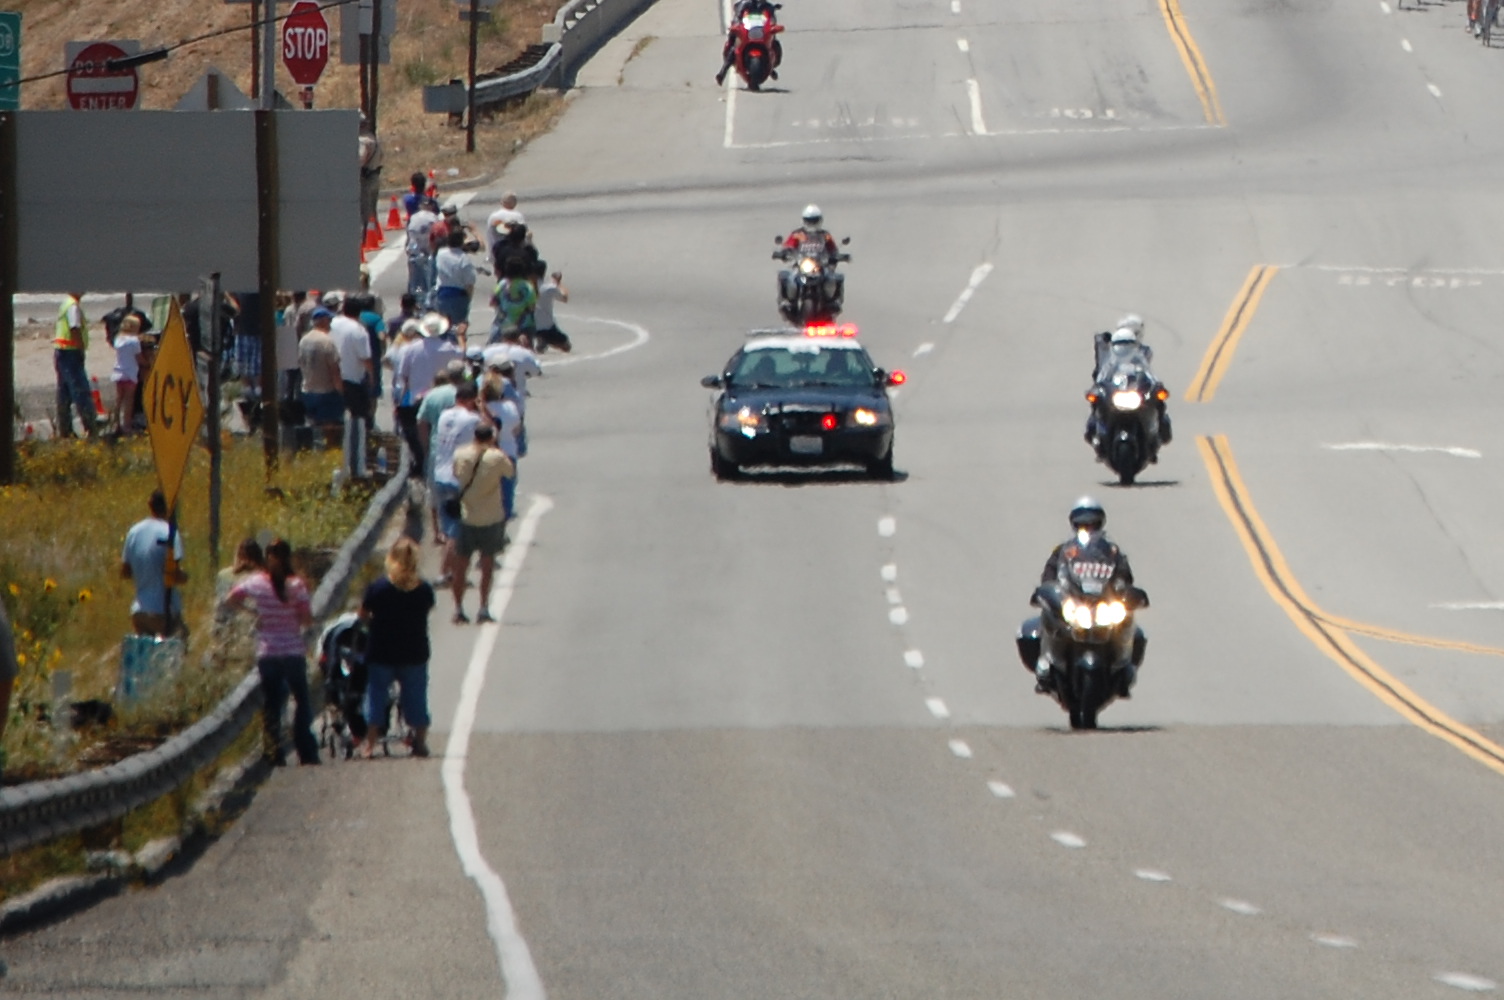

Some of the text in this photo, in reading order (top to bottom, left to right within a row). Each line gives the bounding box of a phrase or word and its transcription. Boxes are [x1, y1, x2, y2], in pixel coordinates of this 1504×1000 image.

[284, 27, 327, 60] STOP
[79, 96, 126, 110] ENTER
[152, 371, 193, 436] ICY
